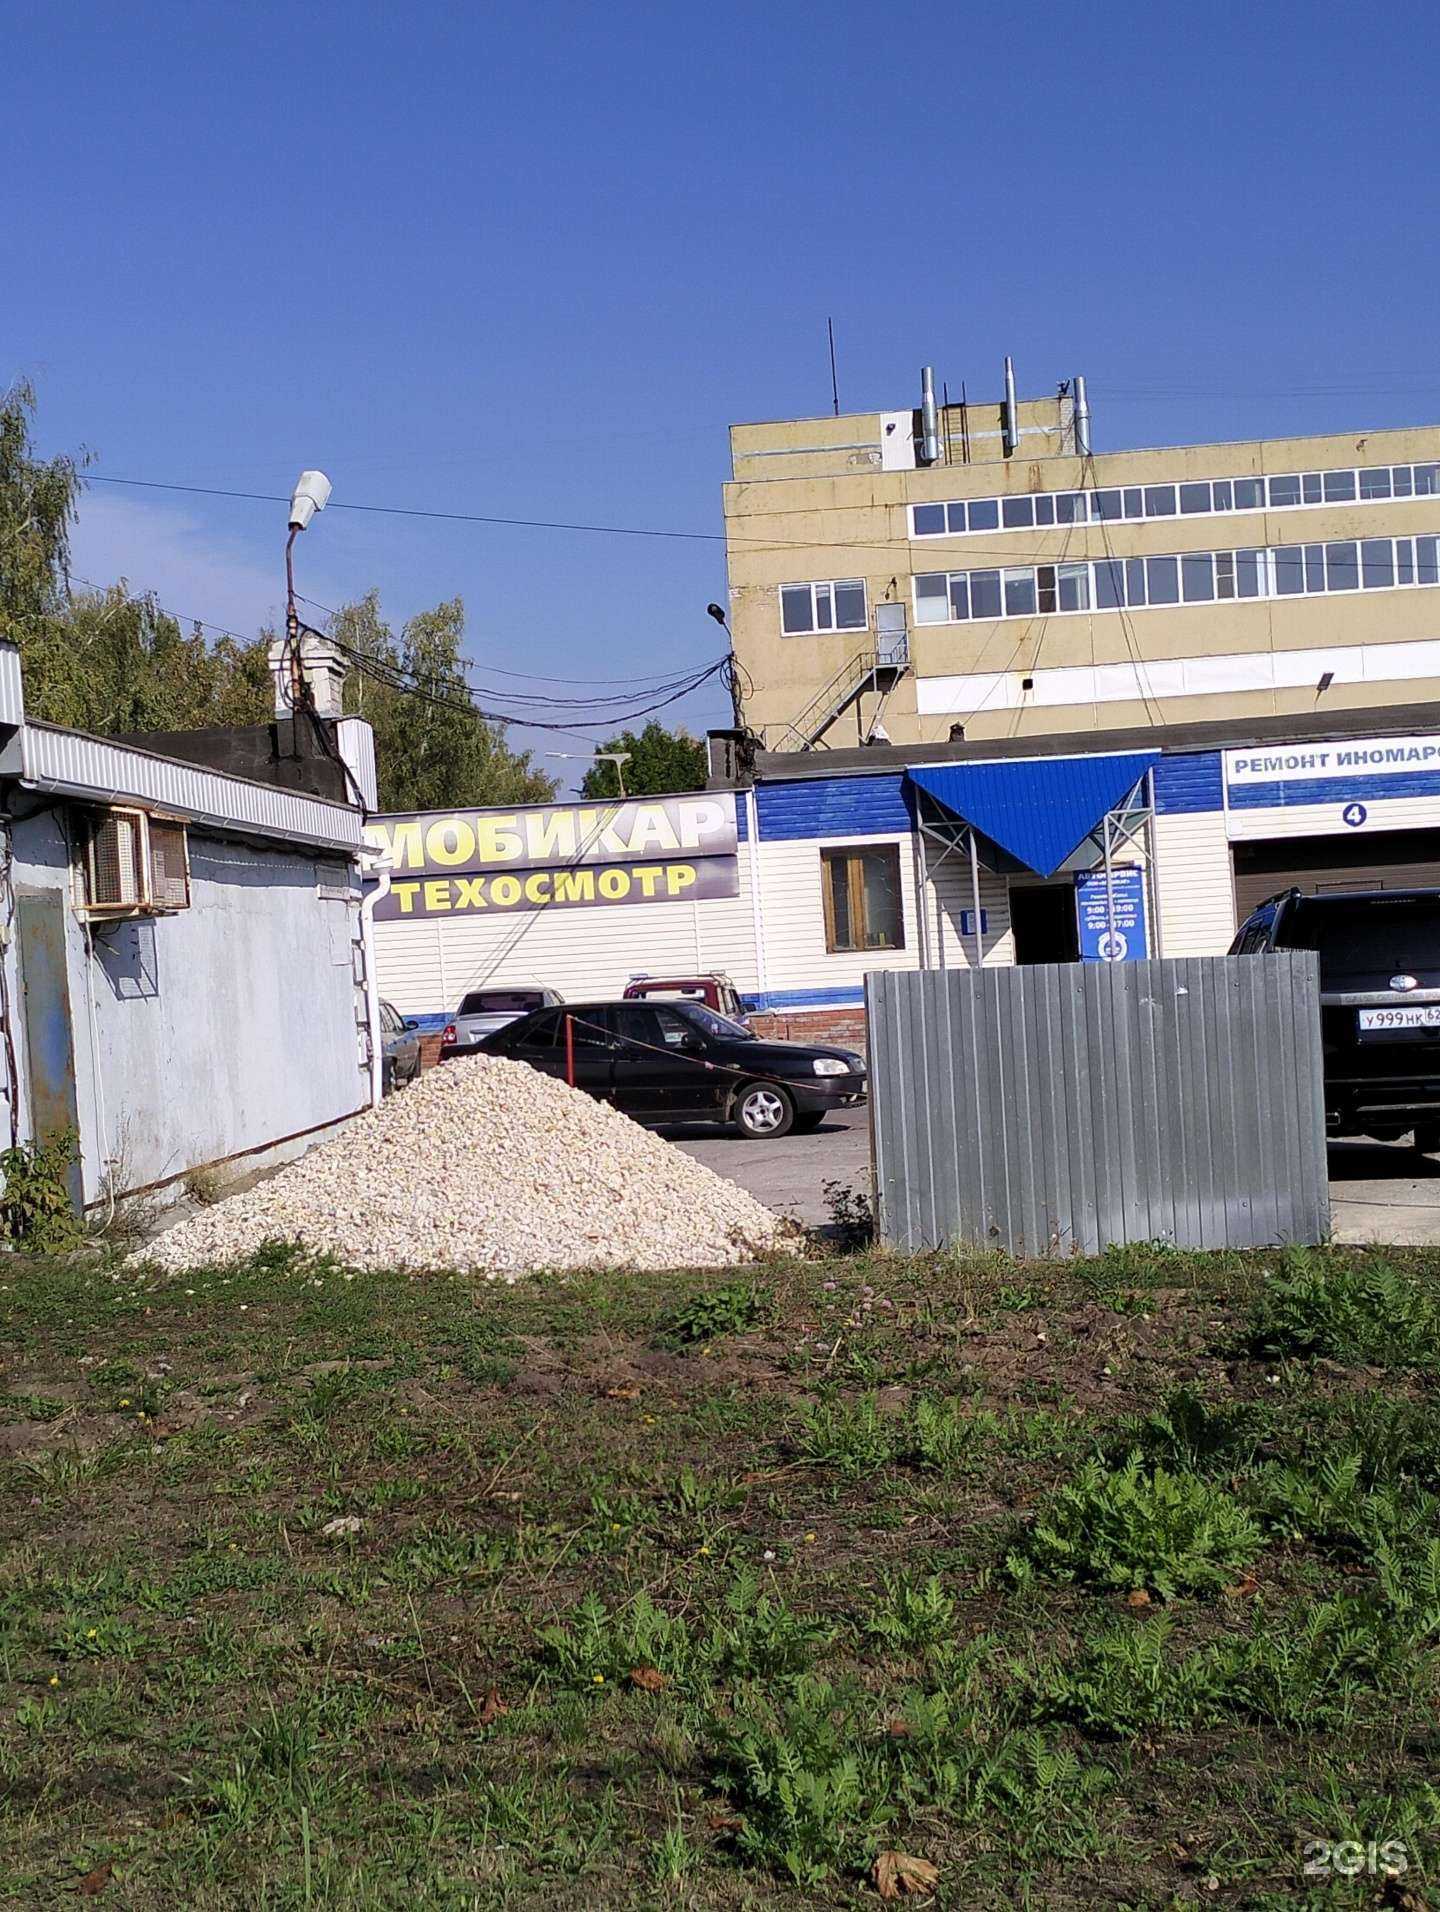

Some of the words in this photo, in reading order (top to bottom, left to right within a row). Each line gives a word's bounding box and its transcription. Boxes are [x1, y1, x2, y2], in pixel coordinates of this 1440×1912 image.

[1235, 753, 1330, 773] РЕМОНТ
[1347, 805, 1362, 823] 4
[362, 801, 726, 871] МОБИКАР
[391, 865, 698, 913] ТЕХОСМОТР
[1088, 921, 1106, 930] 9:00
